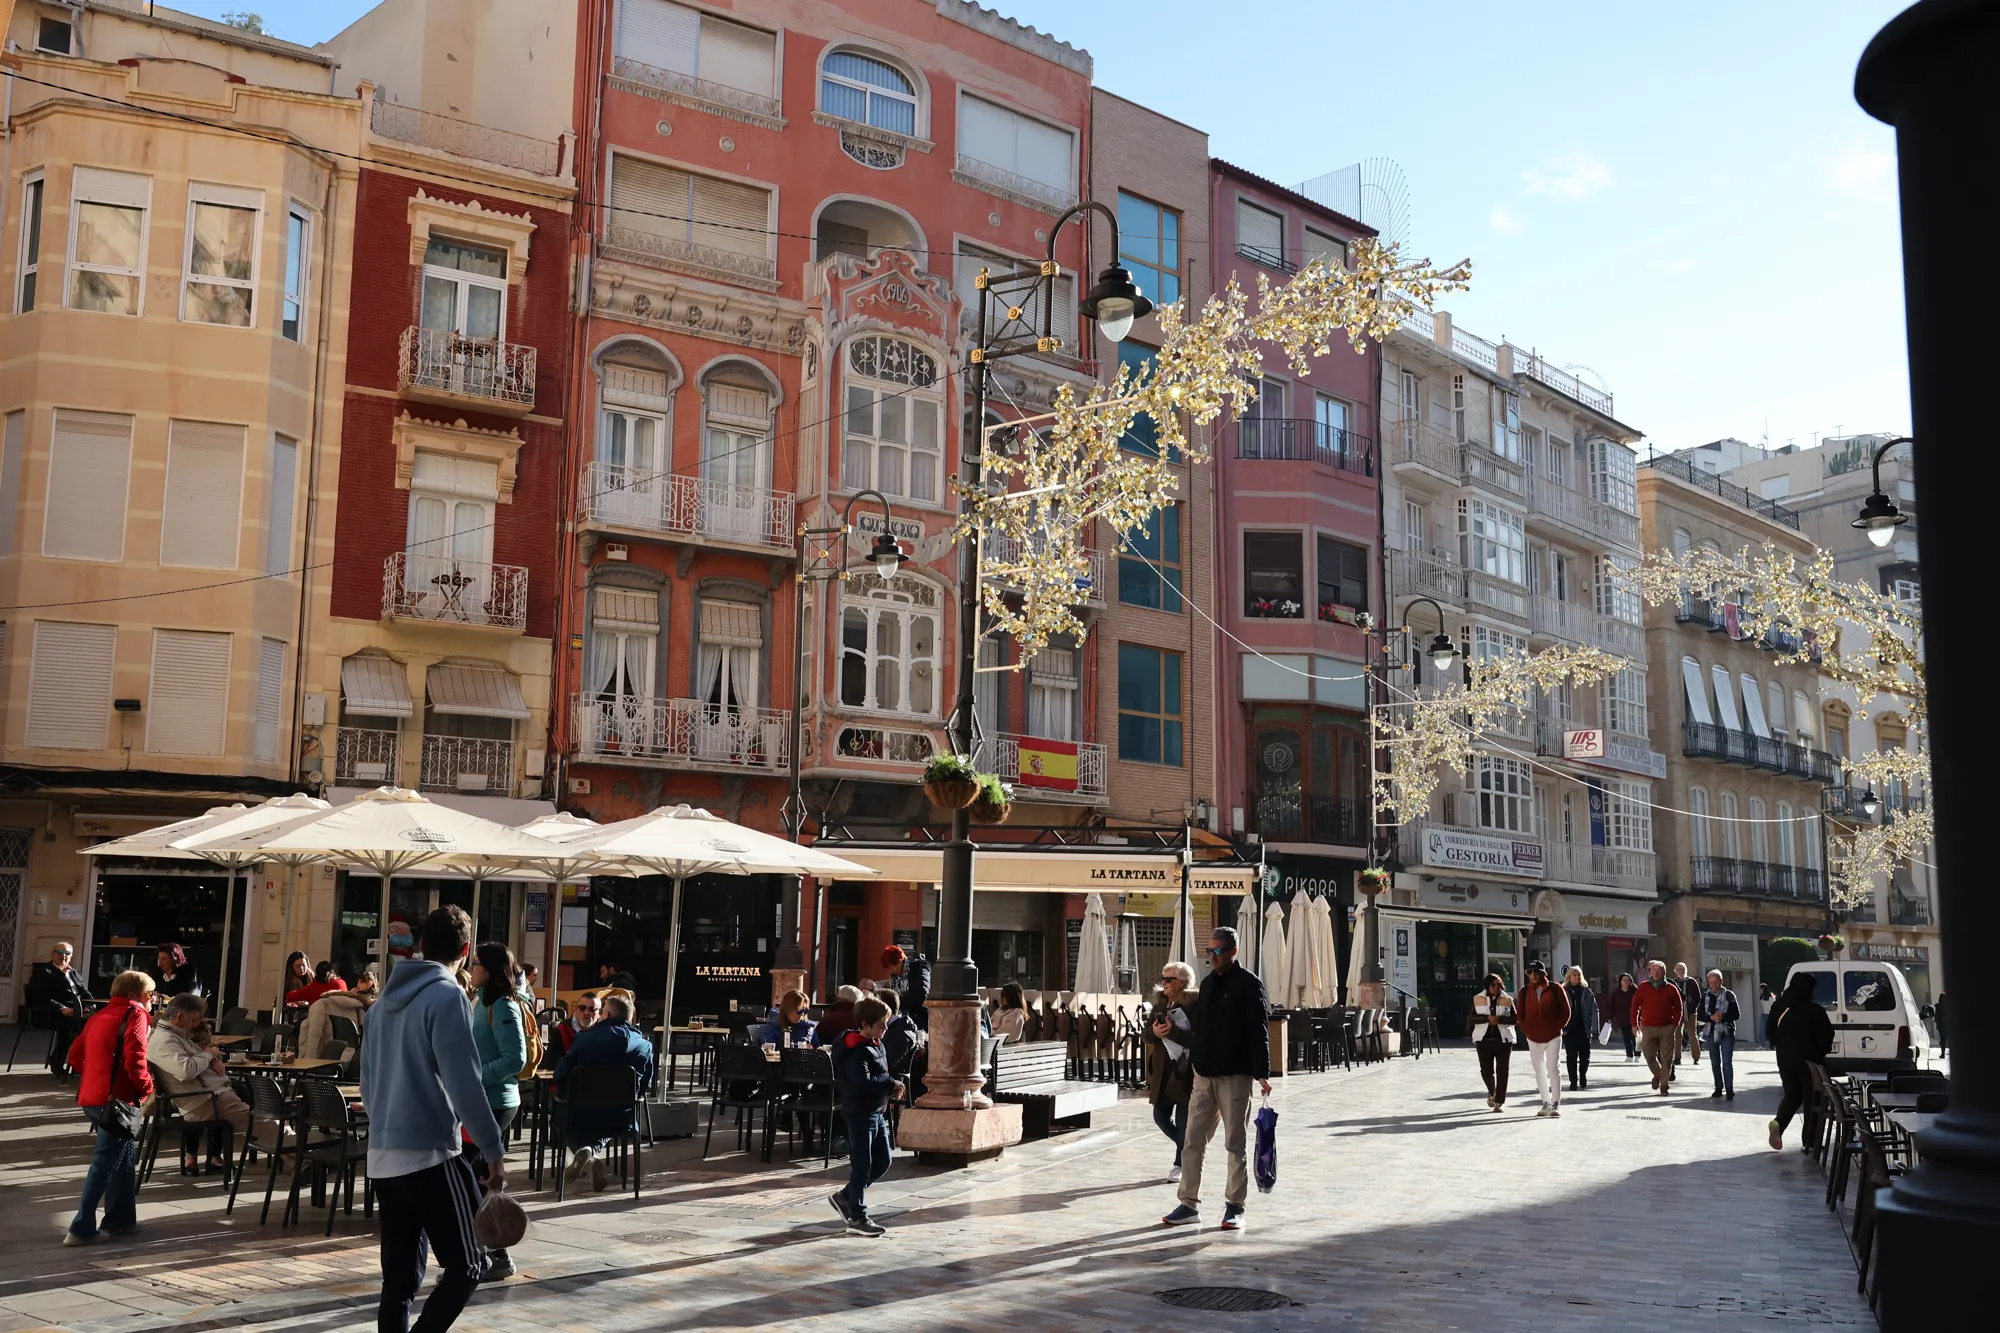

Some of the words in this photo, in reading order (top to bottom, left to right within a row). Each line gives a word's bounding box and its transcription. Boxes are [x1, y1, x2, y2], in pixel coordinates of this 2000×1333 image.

[886, 283, 907, 304] 1906
[1444, 835, 1479, 848] CORREDURÍA
[1480, 840, 1486, 848] DE
[1487, 841, 1510, 851] SEGUROS
[1513, 843, 1541, 856] FERRER
[1446, 848, 1510, 866] GESTORÍA
[1091, 869, 1107, 879] LA
[1108, 870, 1166, 880] TARTANA
[1194, 880, 1245, 890] TARTANA
[1511, 894, 1518, 907] 8
[1604, 915, 1628, 931] oxford
[1869, 945, 1896, 959] pequeña
[695, 966, 711, 976] LA
[711, 966, 761, 977] TARTANA
